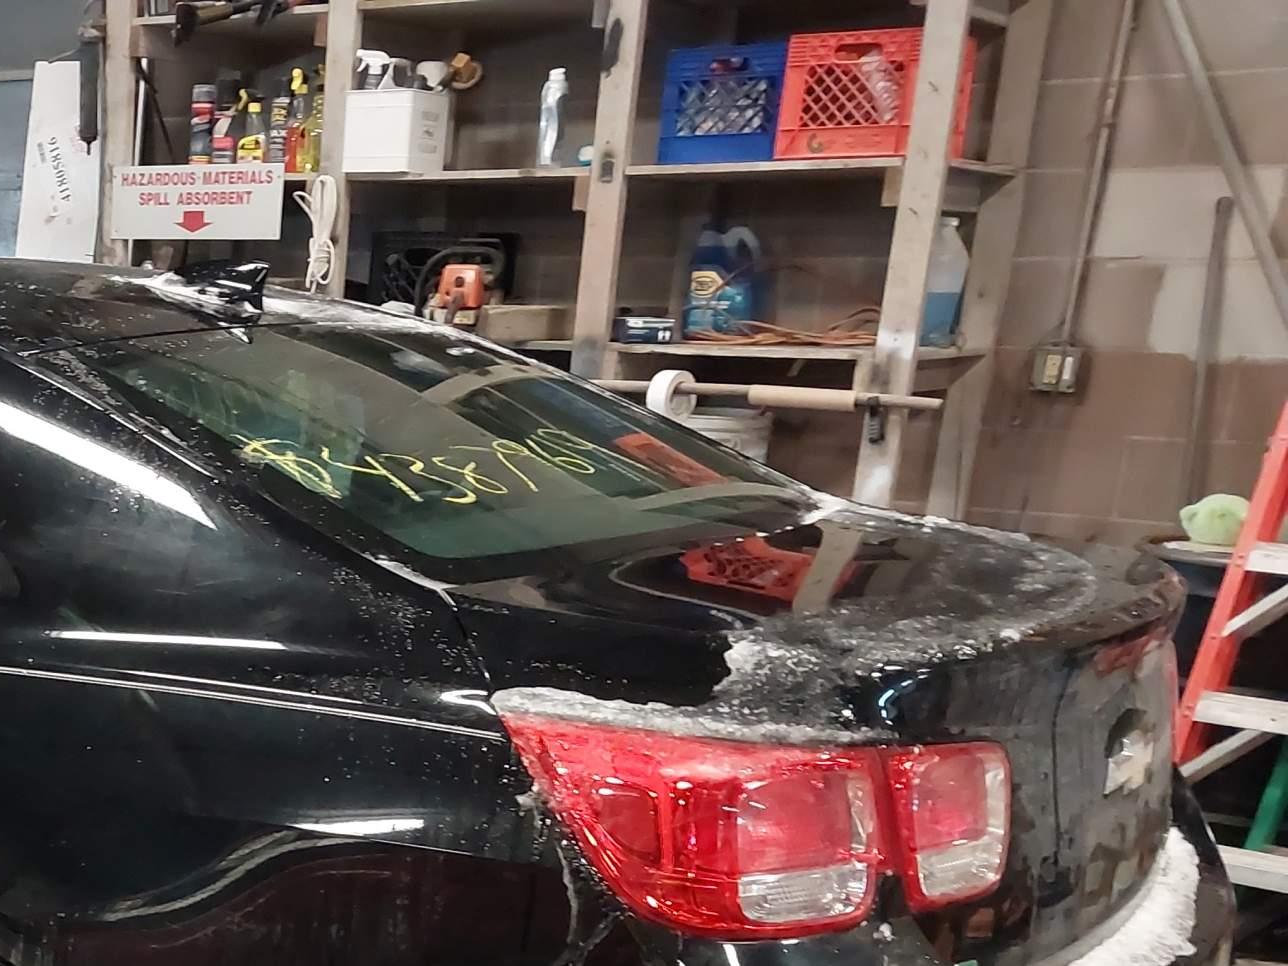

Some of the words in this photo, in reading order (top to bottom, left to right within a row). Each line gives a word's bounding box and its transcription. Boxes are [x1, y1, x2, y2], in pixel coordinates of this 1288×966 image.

[120, 171, 197, 187] HAZARDOUS
[201, 169, 274, 186] MATERIALS
[138, 191, 170, 206] SPILL
[176, 190, 253, 206] ABSORBENT
